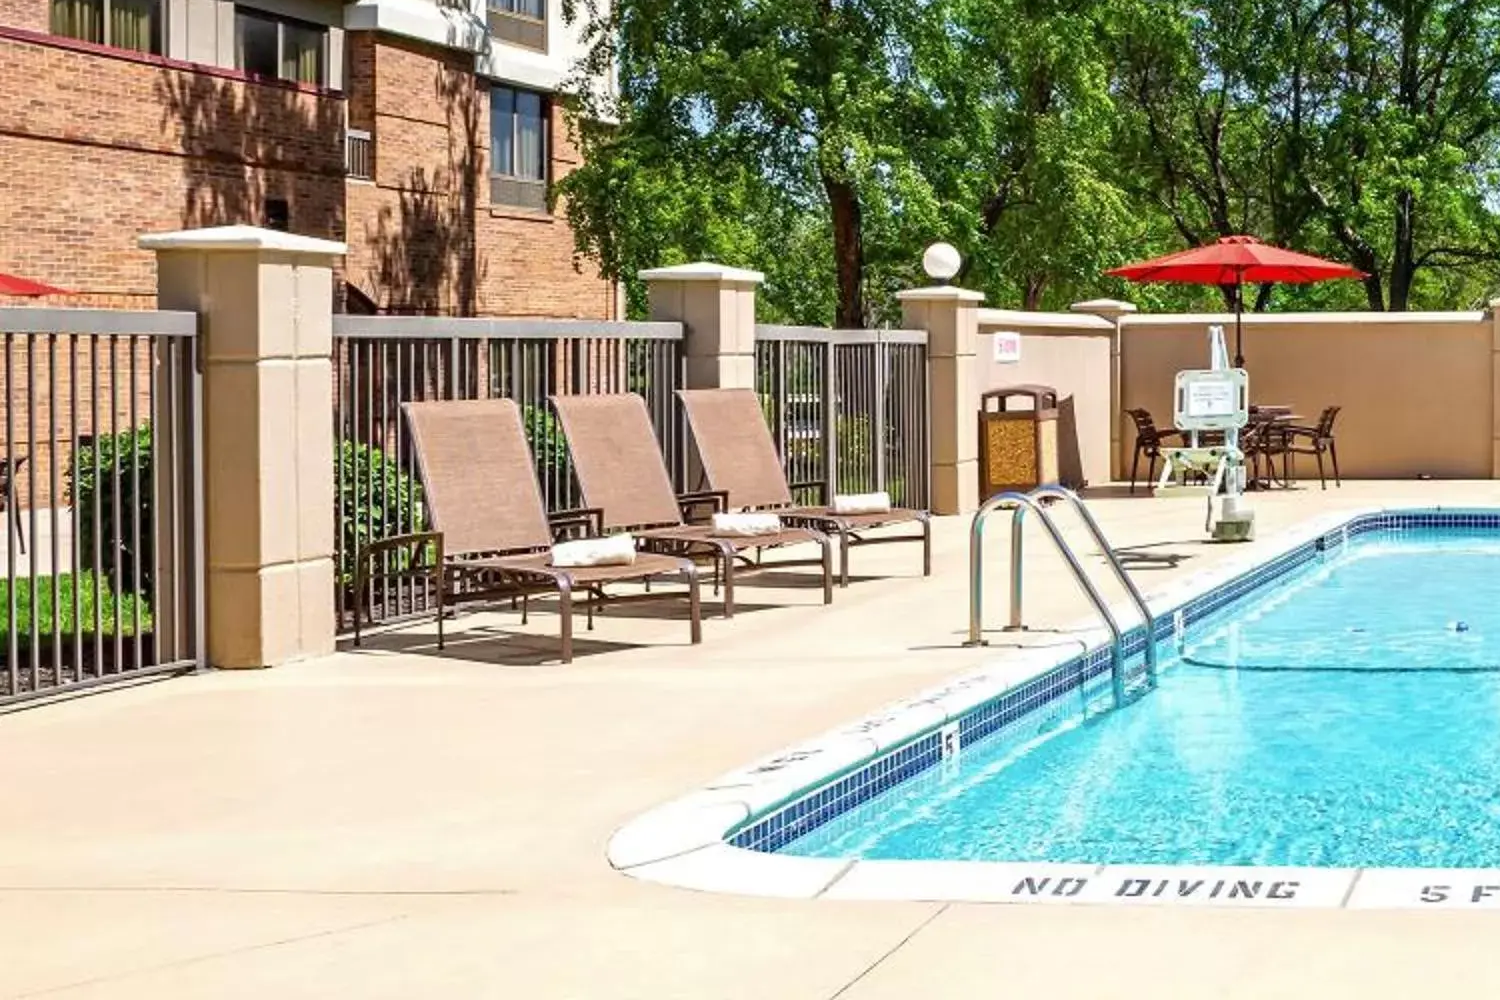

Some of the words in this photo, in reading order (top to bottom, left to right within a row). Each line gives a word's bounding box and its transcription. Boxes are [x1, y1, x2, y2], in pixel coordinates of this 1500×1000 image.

[1012, 877, 1088, 896] NO
[1115, 879, 1300, 899] DIVING
[1420, 886, 1451, 903] 5
